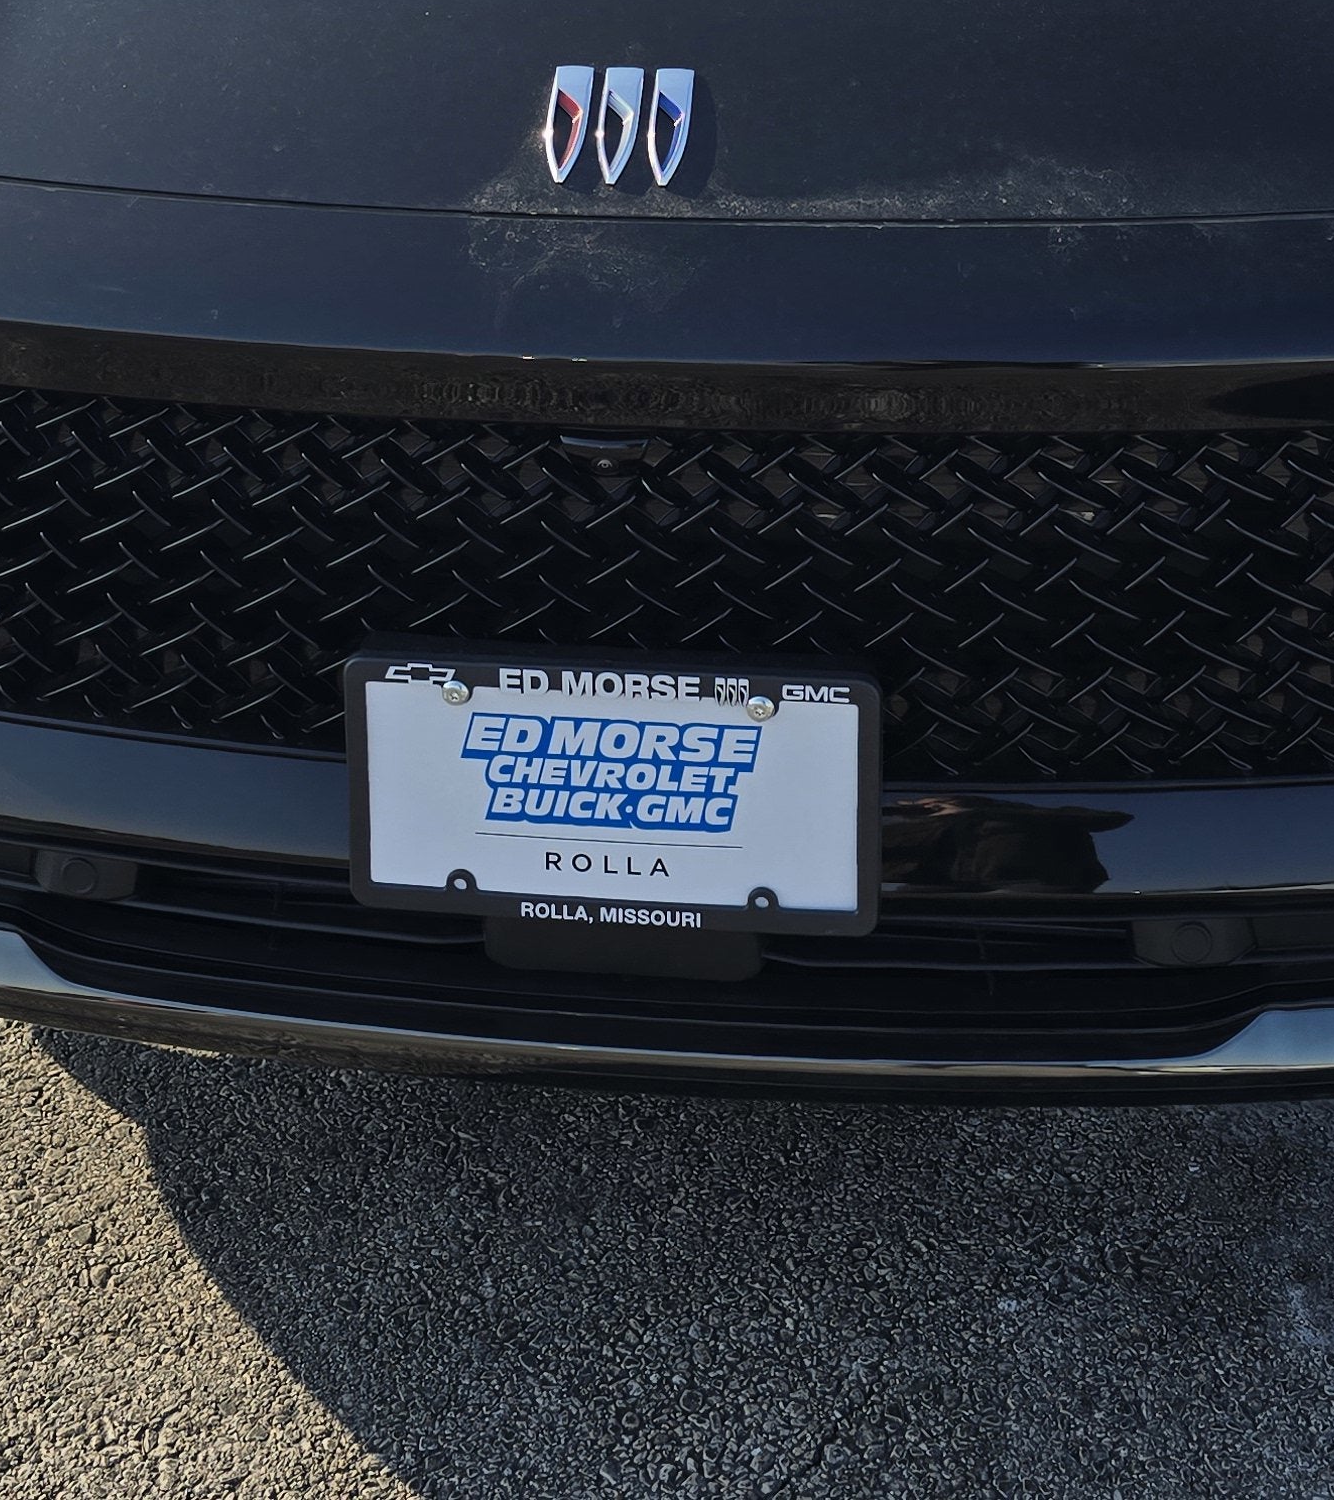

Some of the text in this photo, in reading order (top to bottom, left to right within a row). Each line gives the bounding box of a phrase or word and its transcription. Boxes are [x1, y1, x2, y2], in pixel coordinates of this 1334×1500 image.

[499, 668, 701, 701] ED MORSE
[781, 684, 851, 704] GMC
[466, 715, 761, 763] ED MORSE
[545, 851, 670, 877] ROLLA
[520, 901, 702, 928] ROLLA, MISSOURI
